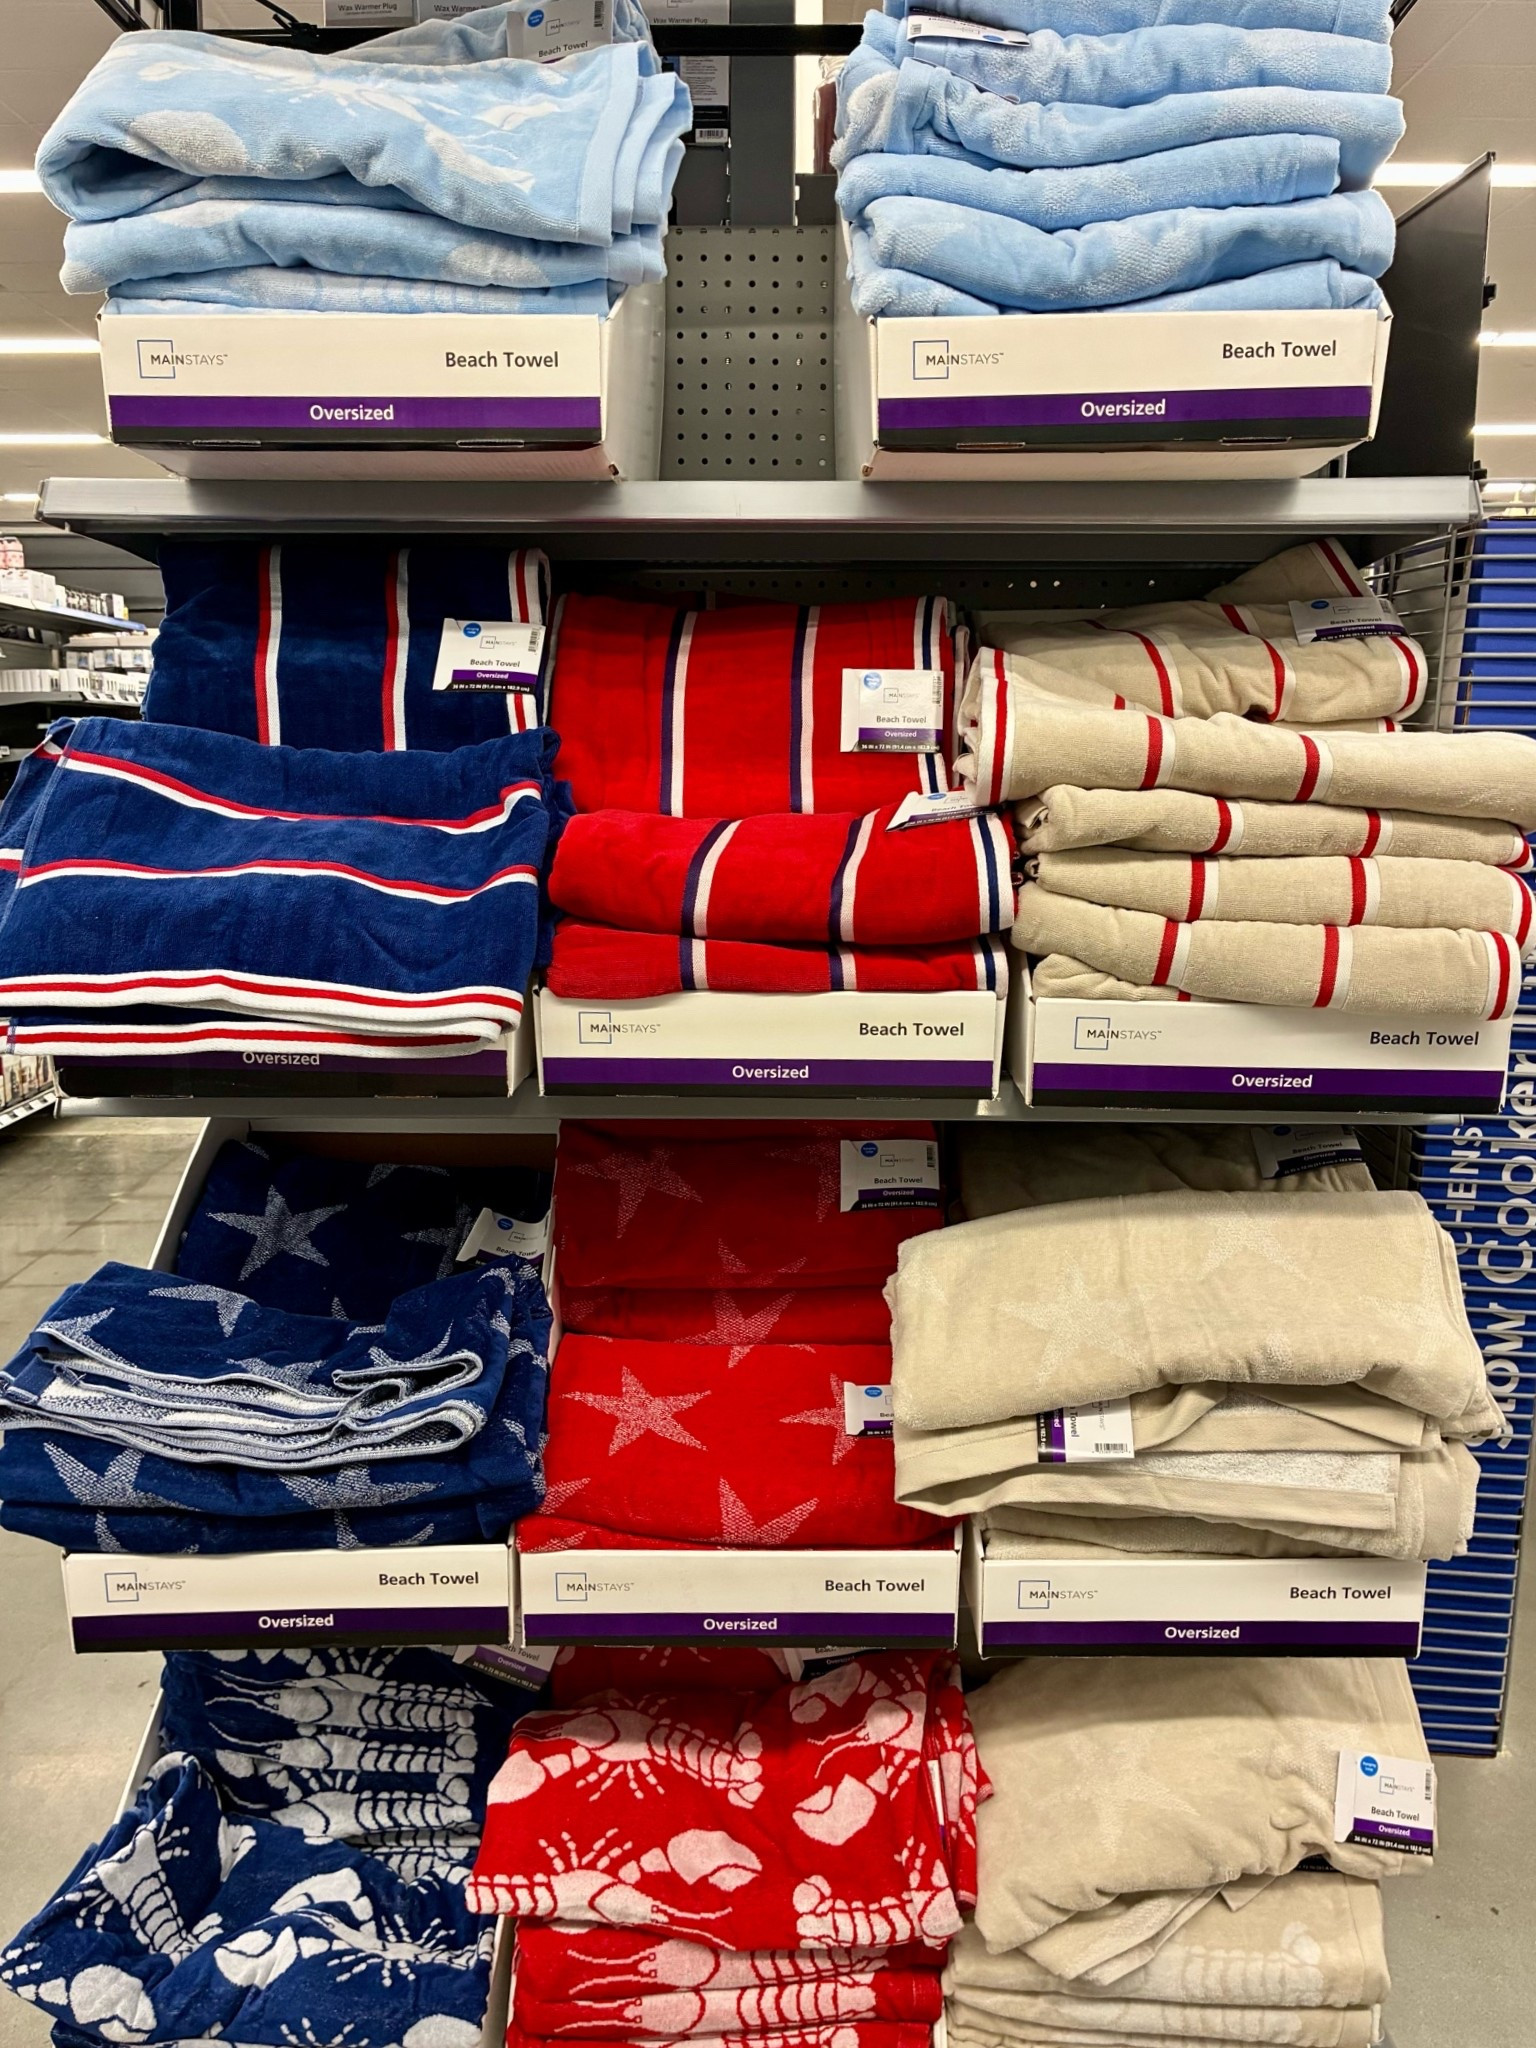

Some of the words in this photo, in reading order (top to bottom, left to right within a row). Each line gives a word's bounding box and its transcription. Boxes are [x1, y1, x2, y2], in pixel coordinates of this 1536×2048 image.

[382, 2, 397, 11] Plug
[434, 4, 449, 12] Wax
[538, 46, 561, 57] Beach
[563, 40, 588, 51] Towel
[1222, 342, 1275, 359] Beach
[1281, 340, 1337, 357] Towel
[150, 354, 227, 365] MAINSTAYS
[445, 351, 498, 368] Beach
[503, 351, 559, 368] Towel
[926, 352, 1003, 365] MAINSTAYS
[309, 404, 394, 420] Oversized
[1081, 399, 1166, 418] Oversized
[470, 659, 493, 667] Beach
[496, 660, 520, 668] Towel
[876, 715, 899, 723] Beach
[902, 715, 927, 723] Towel
[590, 1023, 660, 1034] MAINSTAYS
[859, 1022, 907, 1036] Beach
[913, 1022, 964, 1036] Towel
[1087, 1029, 1161, 1040] MAINSTAYS
[1370, 1031, 1420, 1045] Beach
[1426, 1031, 1479, 1046] Towel
[242, 1052, 320, 1065] Oversized
[732, 1065, 810, 1080] Oversized
[1231, 1073, 1313, 1089] Oversized
[1477, 1052, 1536, 1284] Cooker
[874, 1176, 897, 1184] Beach
[1070, 1411, 1080, 1437] Towel
[378, 1572, 426, 1586] Beach
[430, 1571, 479, 1585] Towel
[824, 1579, 871, 1592] Beach
[876, 1579, 925, 1592] Towel
[116, 1580, 185, 1592] MAINSTAYS
[566, 1582, 634, 1592] MAINSTAYS
[1290, 1586, 1337, 1599] Beach
[1342, 1586, 1391, 1599] Towel
[1029, 1590, 1098, 1599] MAINSTAYS
[258, 1614, 334, 1629] Oversized
[703, 1617, 778, 1631] Oversized
[1164, 1626, 1240, 1640] Oversized
[518, 1648, 540, 1662] Towel
[498, 1657, 526, 1672] Oversized
[1371, 1806, 1394, 1818] Beach
[1396, 1810, 1420, 1821] Towel
[1378, 1825, 1411, 1837] Oversized
